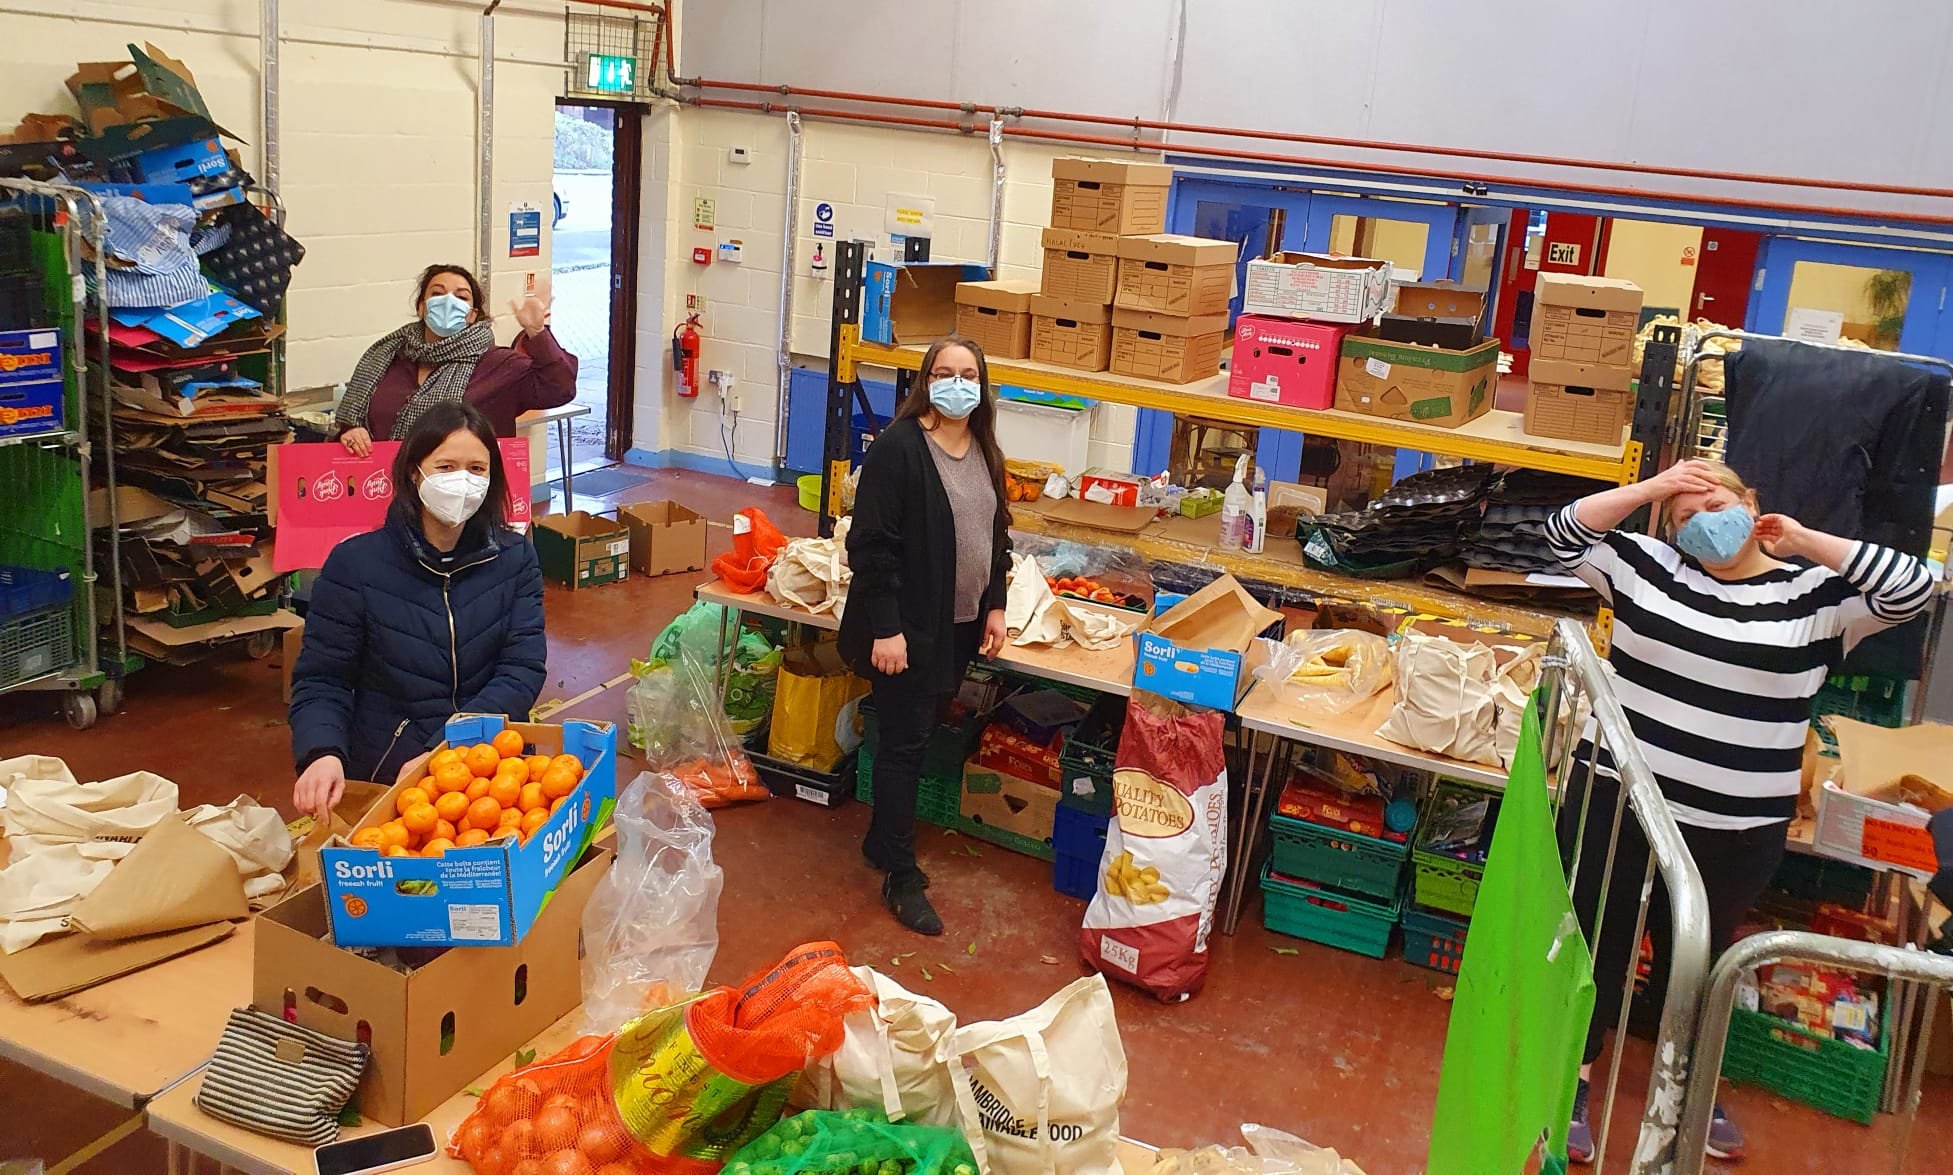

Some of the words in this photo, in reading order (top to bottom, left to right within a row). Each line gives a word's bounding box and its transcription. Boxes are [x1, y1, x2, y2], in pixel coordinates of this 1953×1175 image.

[1549, 244, 1575, 263] Exit
[883, 271, 893, 297] Sorli
[1144, 641, 1176, 659] Sorli
[1113, 779, 1164, 808] UALITY
[543, 802, 578, 863] Sorli
[335, 860, 393, 879] Sorli
[1103, 941, 1137, 969] 25Kg
[968, 1075, 1025, 1130] AMBRIDGE
[1048, 1124, 1083, 1142] OOD
